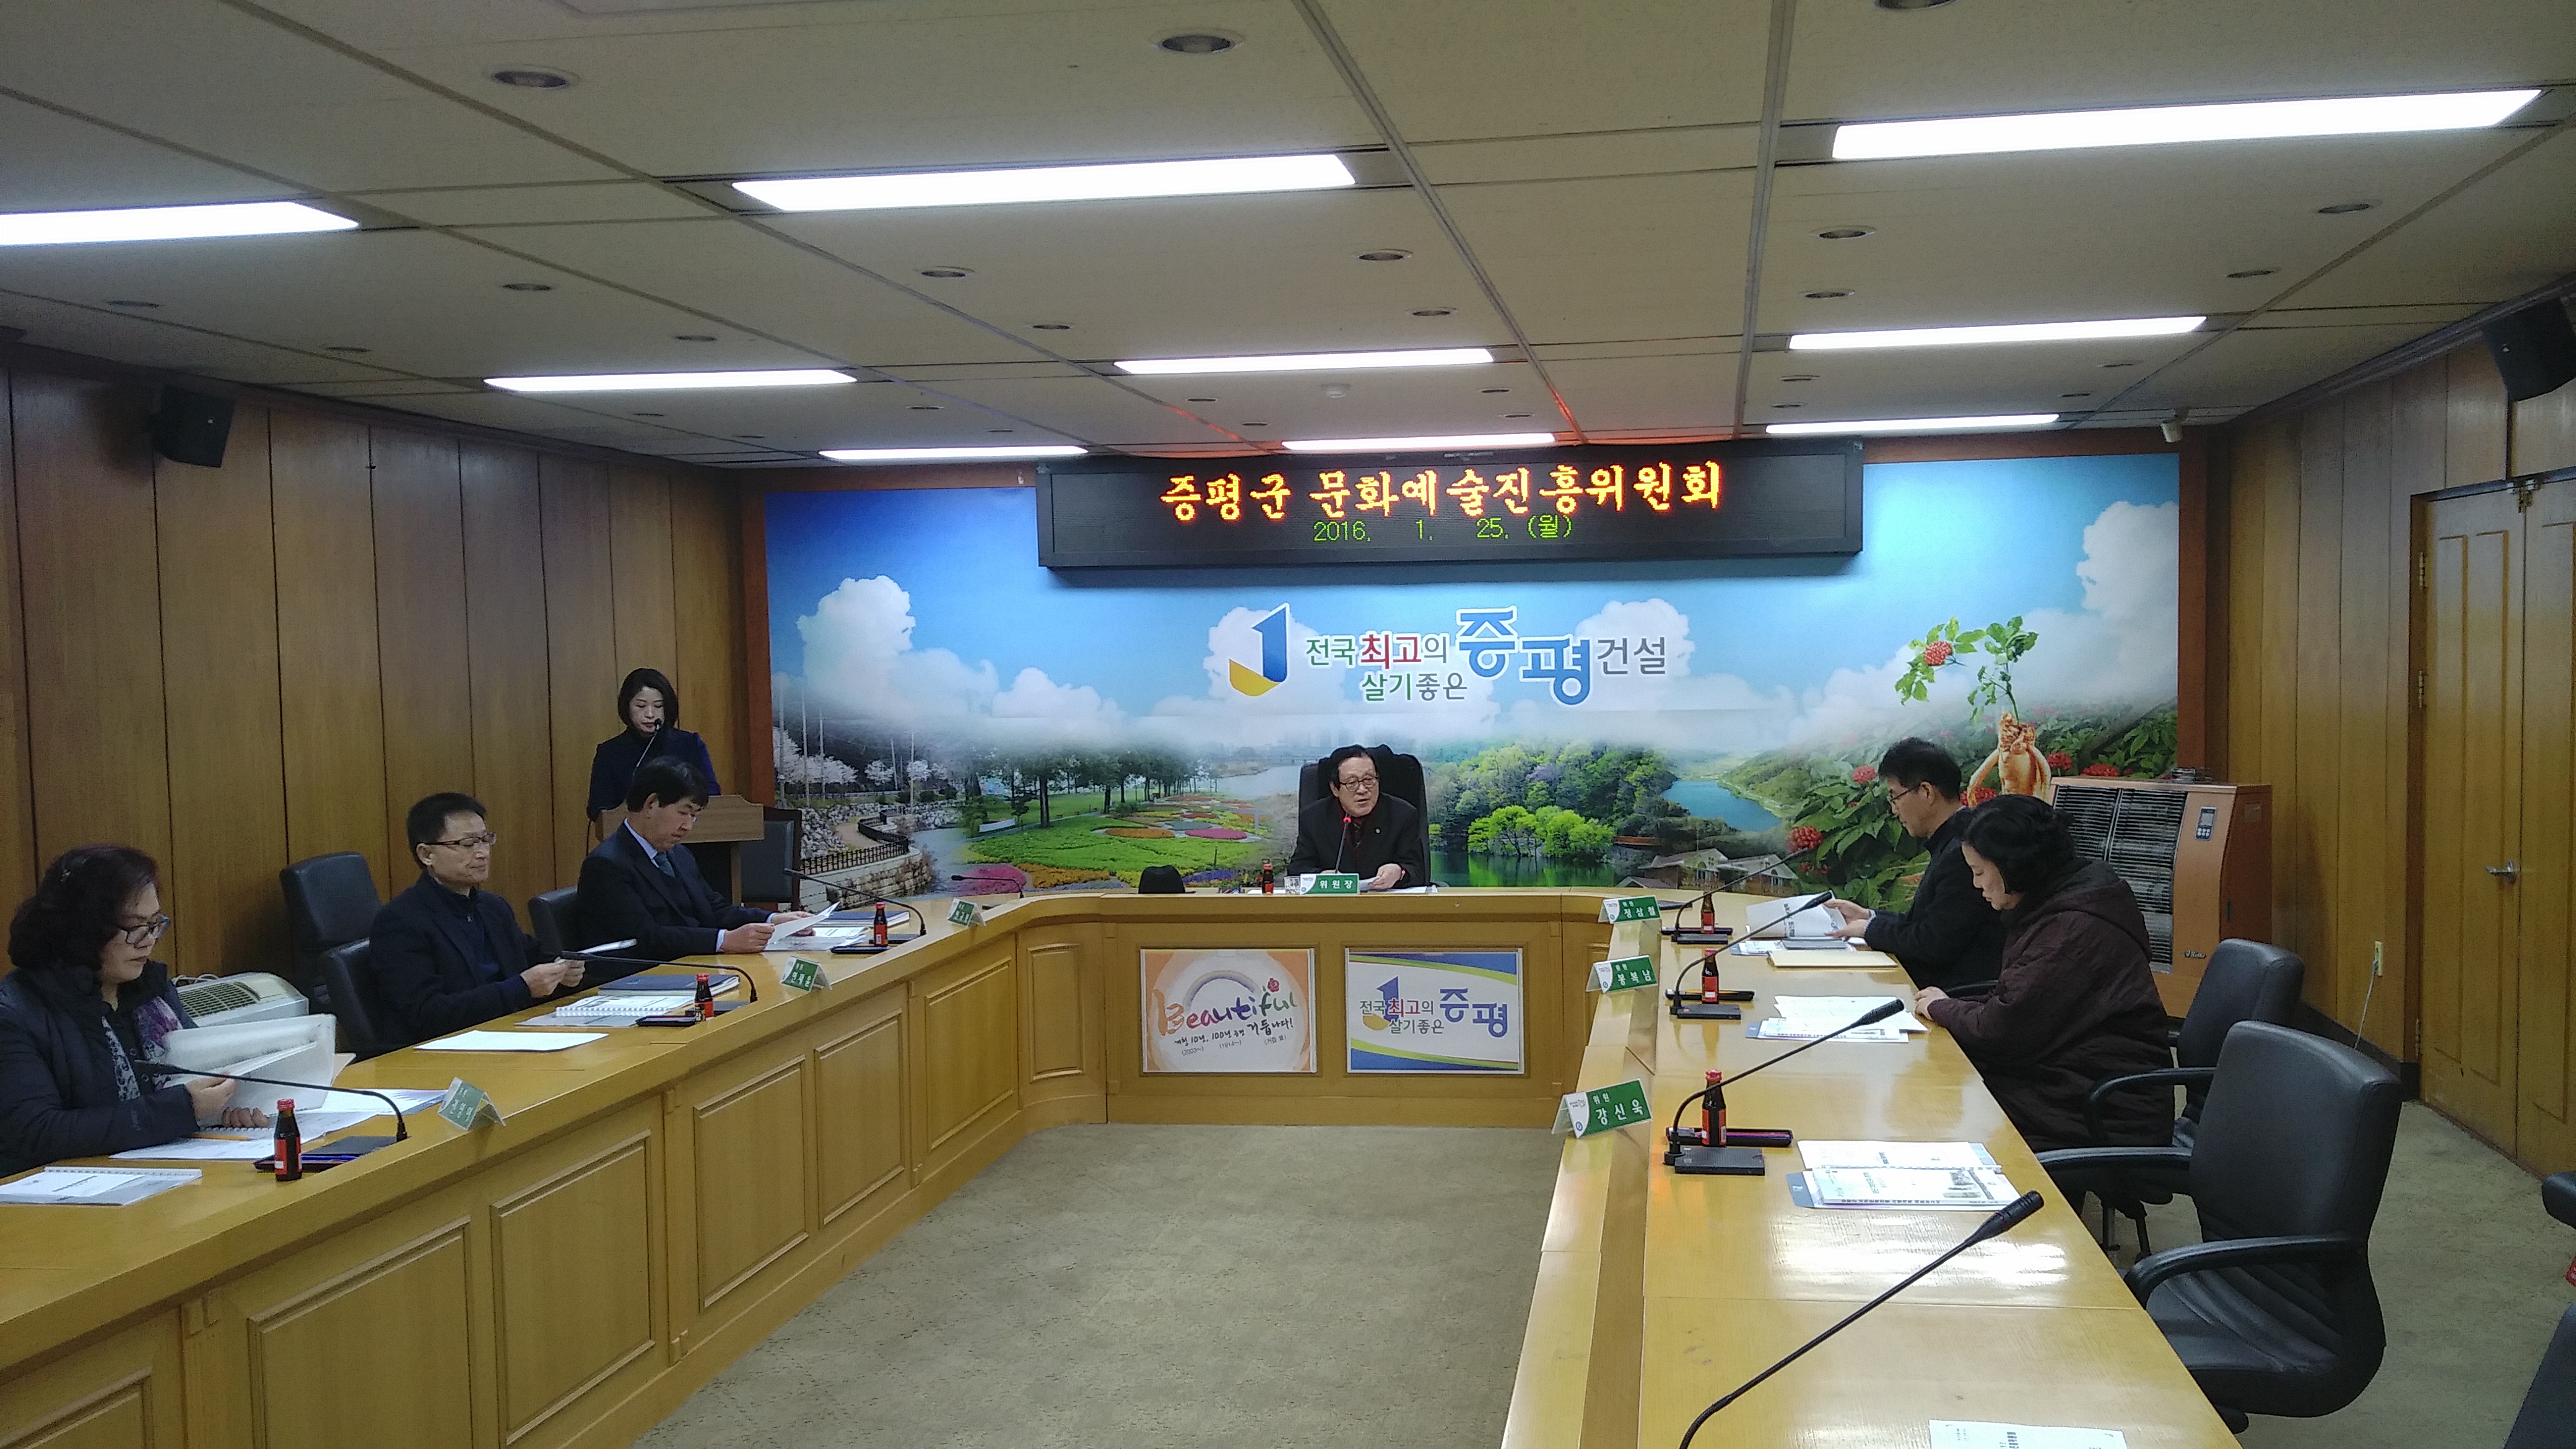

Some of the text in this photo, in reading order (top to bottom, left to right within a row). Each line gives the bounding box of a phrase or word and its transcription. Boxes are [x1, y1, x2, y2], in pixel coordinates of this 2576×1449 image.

[1160, 471, 1292, 522] 증평군
[1313, 514, 1573, 542] 2016. 1. 25. (월)
[1457, 607, 1666, 705] 증평 건설
[1319, 879, 1354, 889] 위원장
[1152, 983, 1298, 1036] Beautiful
[1439, 987, 1508, 1038] 증평
[1595, 1099, 1644, 1126] 강신욱
